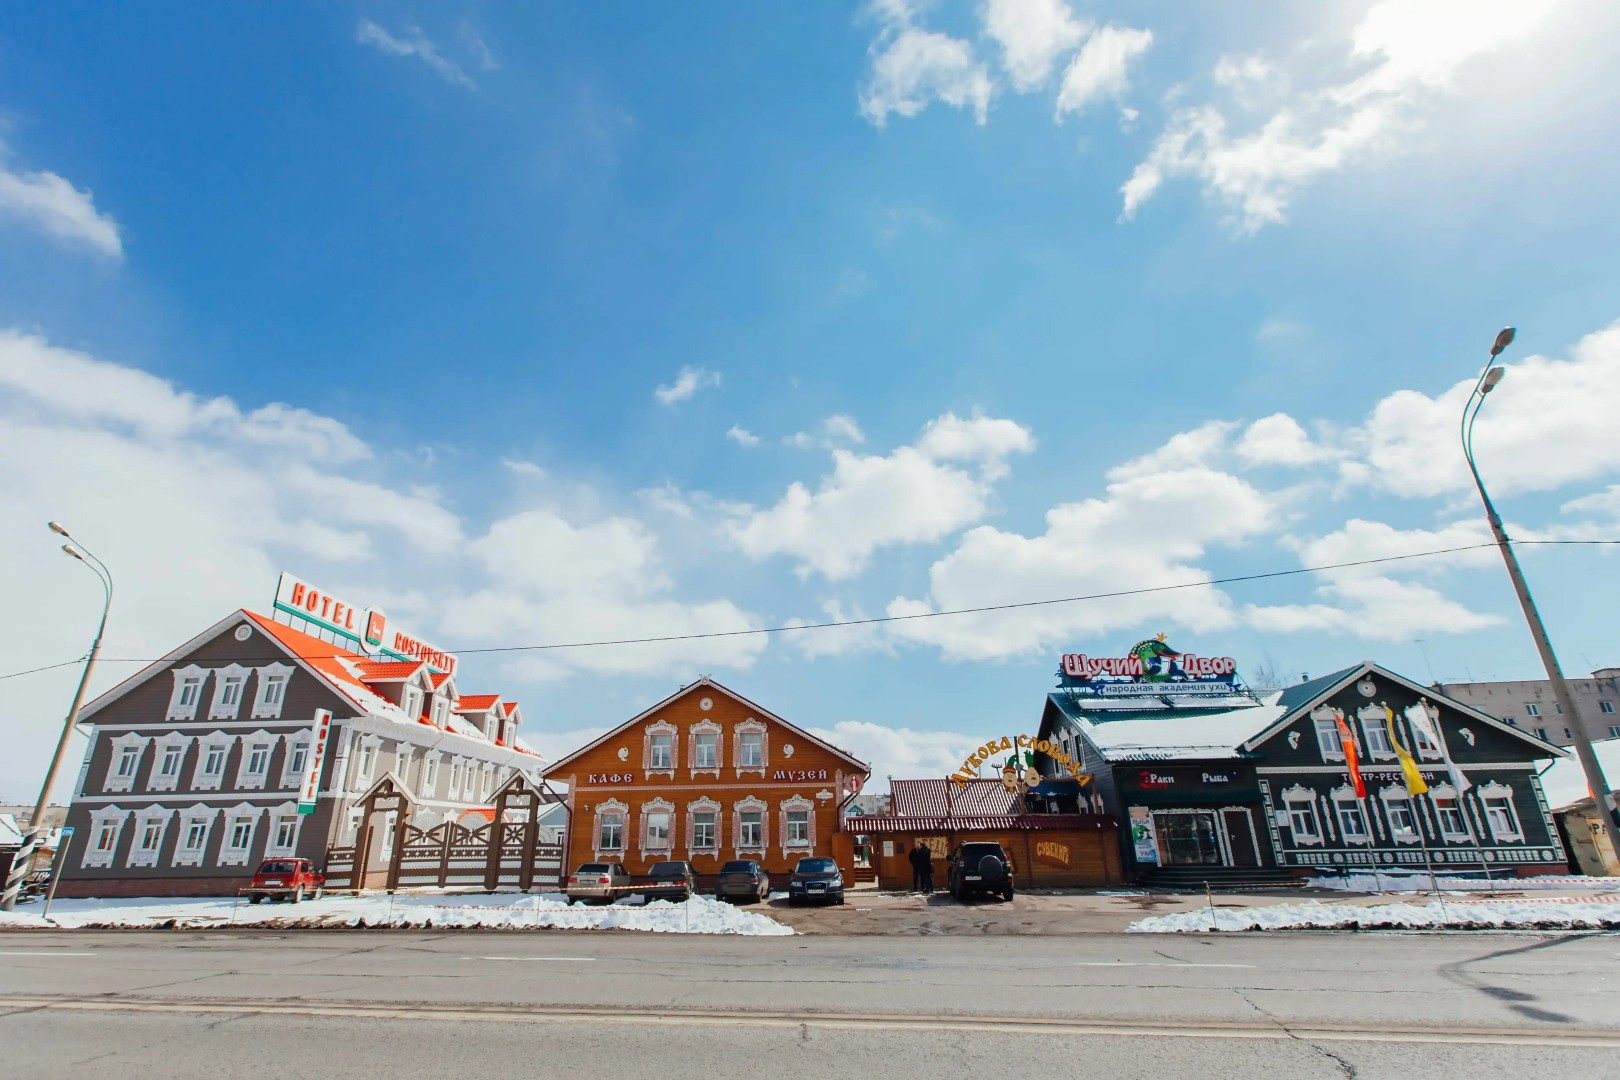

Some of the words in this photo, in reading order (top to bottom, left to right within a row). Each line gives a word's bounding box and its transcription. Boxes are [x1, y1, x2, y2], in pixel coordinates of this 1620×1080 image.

[291, 582, 354, 629] HOTEL
[394, 632, 456, 671] ROSTOVSKIY
[1063, 653, 1144, 680] Щучий
[1183, 654, 1237, 680] Двор
[1106, 685, 1154, 696] народная
[1159, 684, 1206, 693] академия
[1209, 684, 1227, 693] ухи
[308, 715, 330, 798] HOSTEL
[774, 769, 827, 782] МУЗЕЙ
[1341, 772, 1435, 781] ТТР-РЕСТАН
